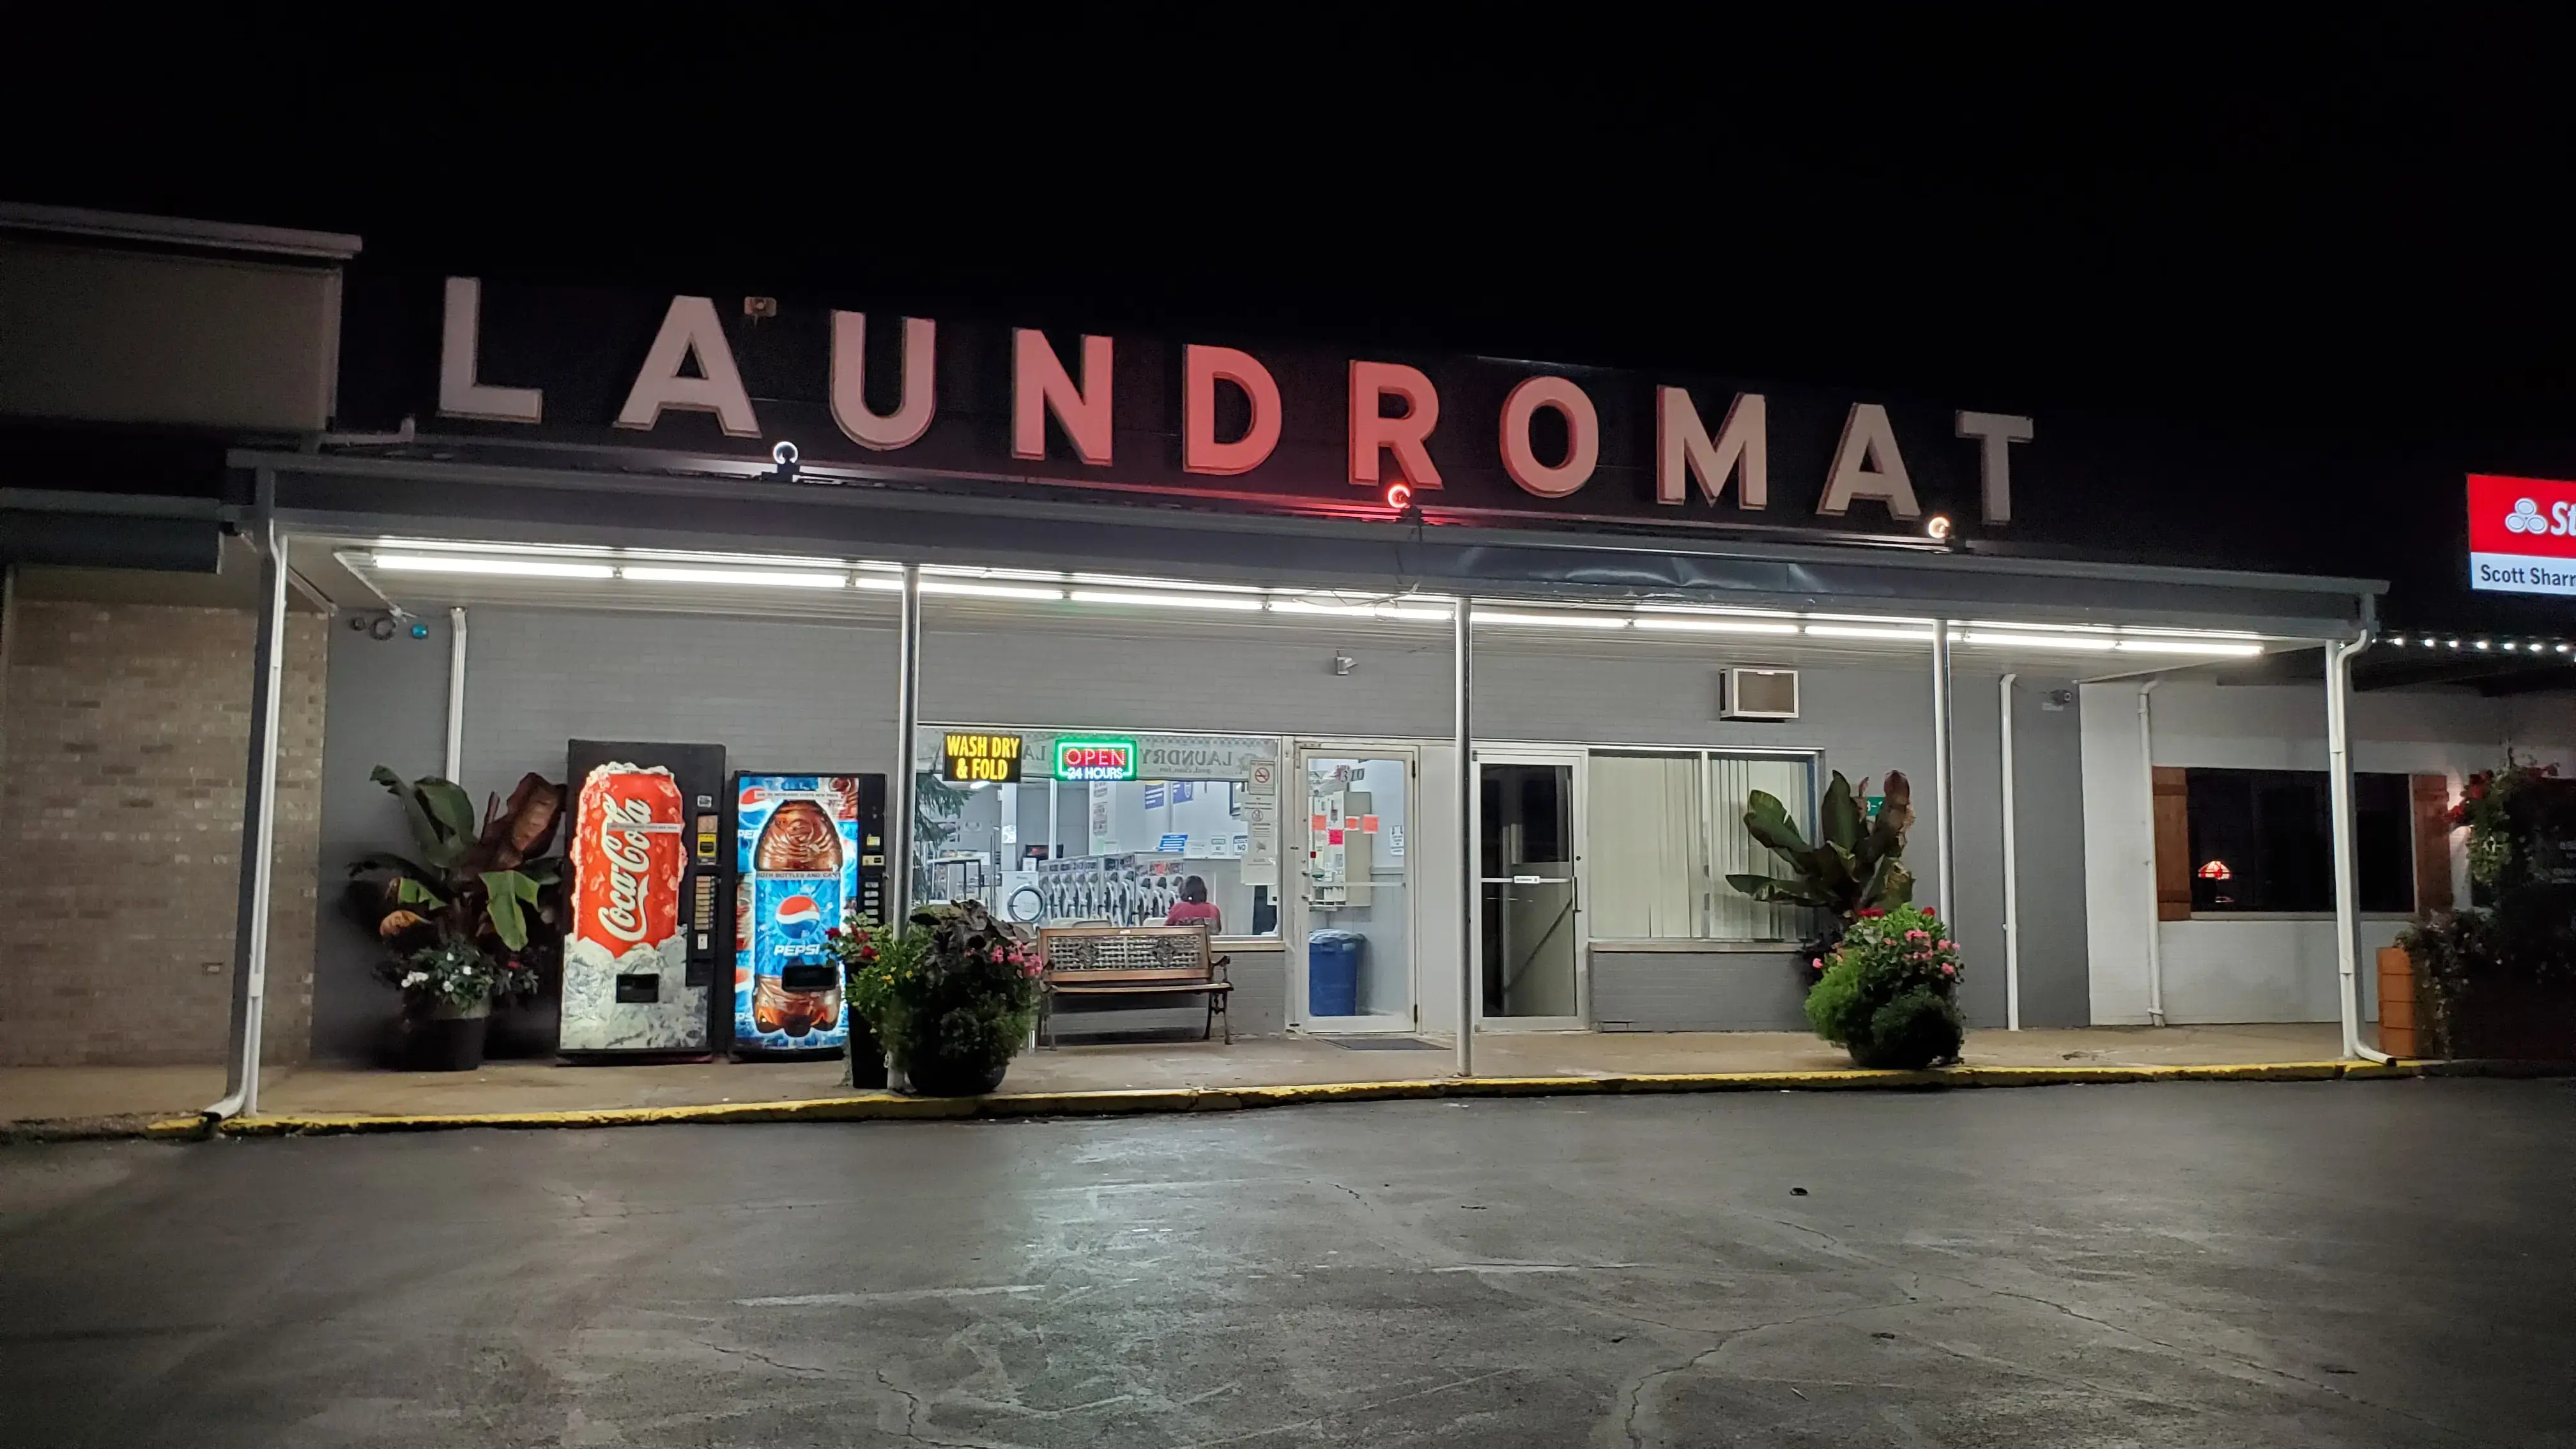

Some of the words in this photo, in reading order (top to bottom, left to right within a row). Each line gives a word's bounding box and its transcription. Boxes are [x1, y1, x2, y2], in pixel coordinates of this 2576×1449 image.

[438, 276, 2034, 523] LAUNDROMAT
[2481, 564, 2525, 584] Scott
[946, 735, 988, 757] WASH
[992, 737, 1020, 758] DRY
[1064, 748, 1126, 767] OPEN
[956, 758, 969, 779] &
[972, 758, 1008, 780] FOLD
[1067, 767, 1082, 779] 24
[1085, 767, 1123, 779] HOURS
[774, 944, 820, 956] PEPSI
